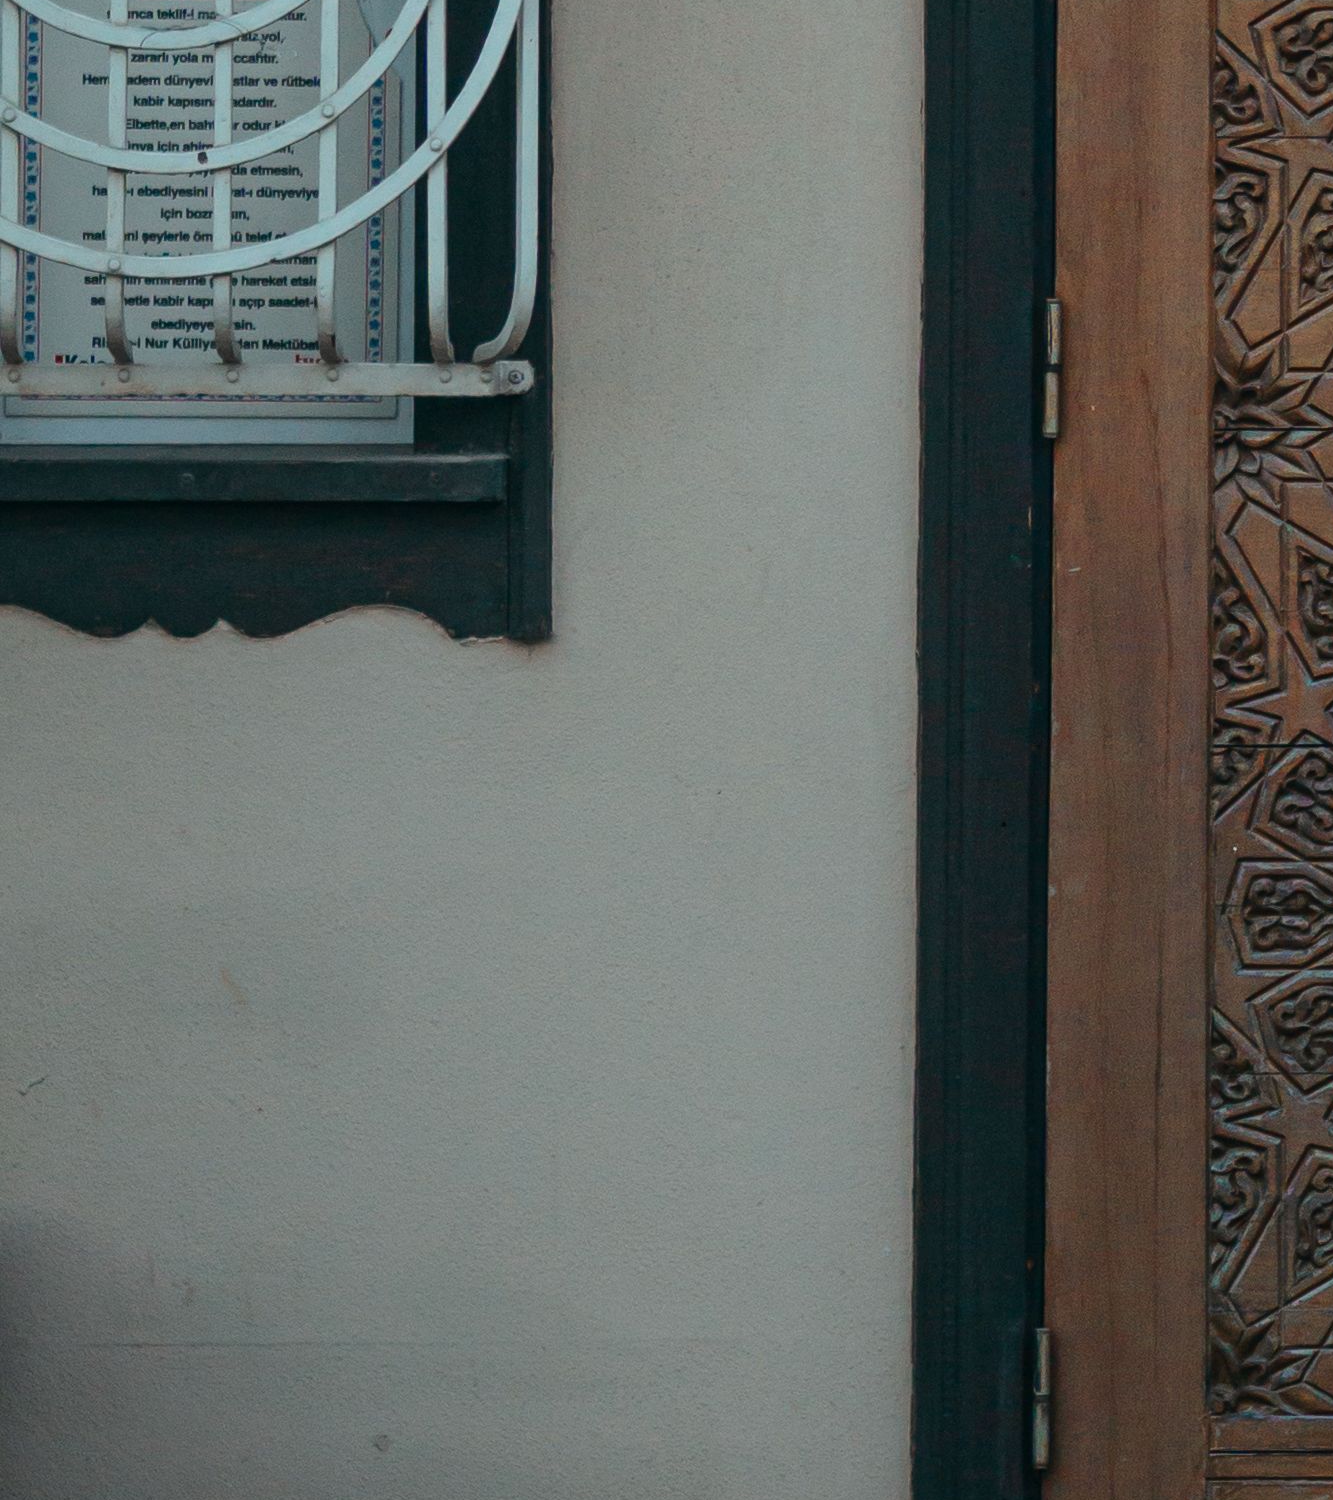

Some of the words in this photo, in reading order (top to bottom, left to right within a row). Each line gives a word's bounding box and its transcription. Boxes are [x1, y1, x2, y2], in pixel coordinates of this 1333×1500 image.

[131, 52, 169, 63] zararlı
[172, 53, 198, 66] yola
[82, 74, 110, 85] Hem
[127, 75, 160, 86] adem
[164, 75, 214, 89] dünyevi
[263, 78, 278, 87] ve
[134, 96, 164, 107] kabir
[233, 98, 277, 108] adardır.
[242, 120, 272, 131] odur
[250, 165, 303, 178] etmesin,
[137, 186, 208, 200] ebediyesini
[256, 187, 319, 201] dünyeviye
[161, 208, 182, 221] için
[142, 231, 189, 244] şeylerle
[245, 231, 272, 242] telef
[241, 275, 288, 287] hareket
[153, 295, 184, 307] kabir
[239, 298, 265, 310] açıp
[151, 319, 215, 333] ebediyeye
[145, 338, 169, 348] Nur
